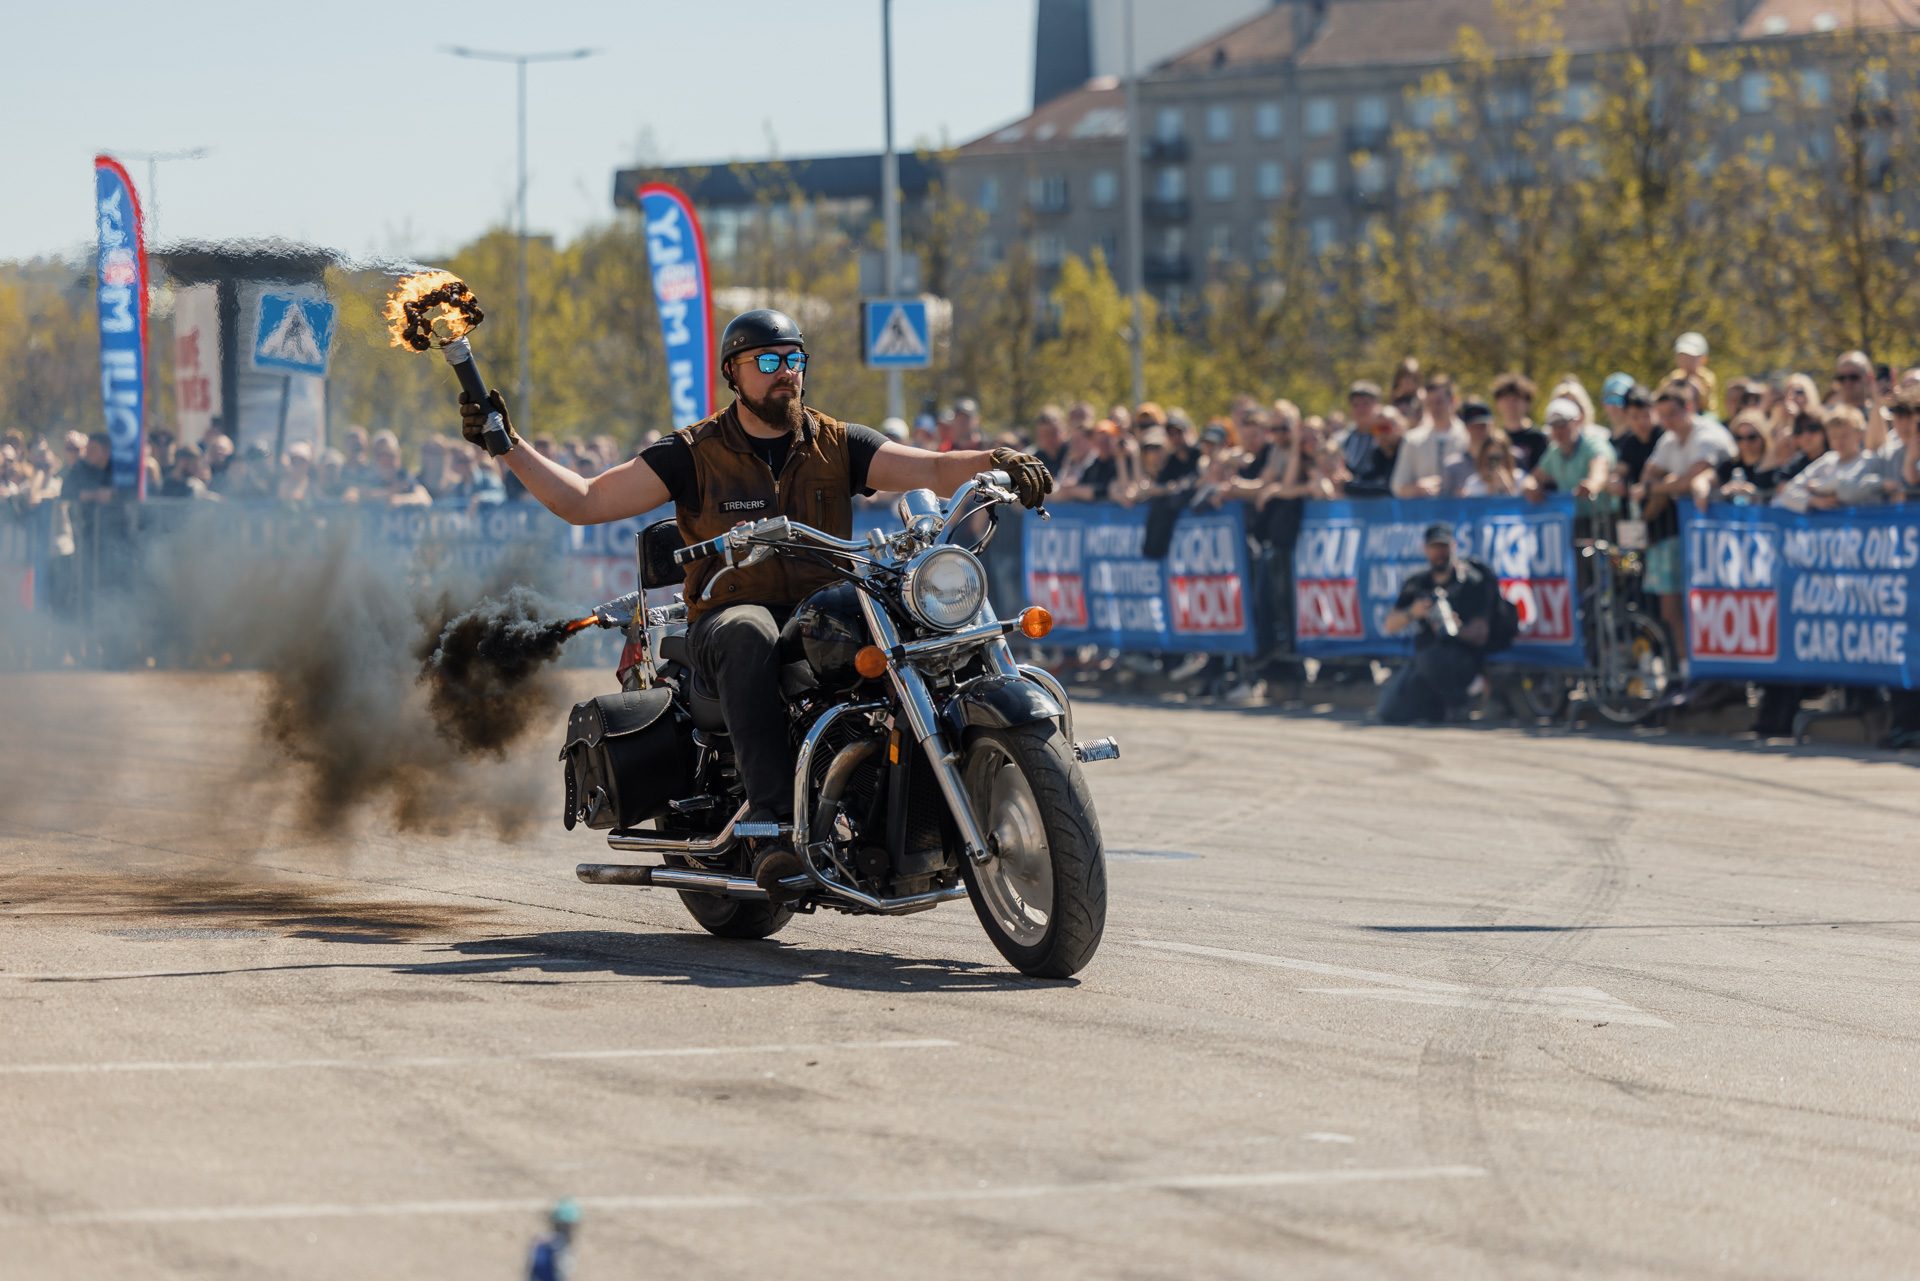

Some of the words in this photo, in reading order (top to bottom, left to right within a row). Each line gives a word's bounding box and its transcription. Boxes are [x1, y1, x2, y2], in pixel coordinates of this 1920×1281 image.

[723, 500, 765, 511] TRENERIS
[1783, 527, 1863, 568] MOTOR
[1863, 525, 1919, 569] OILS
[1169, 580, 1240, 626] MOLY
[1497, 580, 1568, 636] OLY
[1791, 574, 1908, 616] ADDITIVES
[1691, 593, 1776, 652] MOLY
[1794, 620, 1840, 662] CAR
[1842, 622, 1907, 665] CARE
